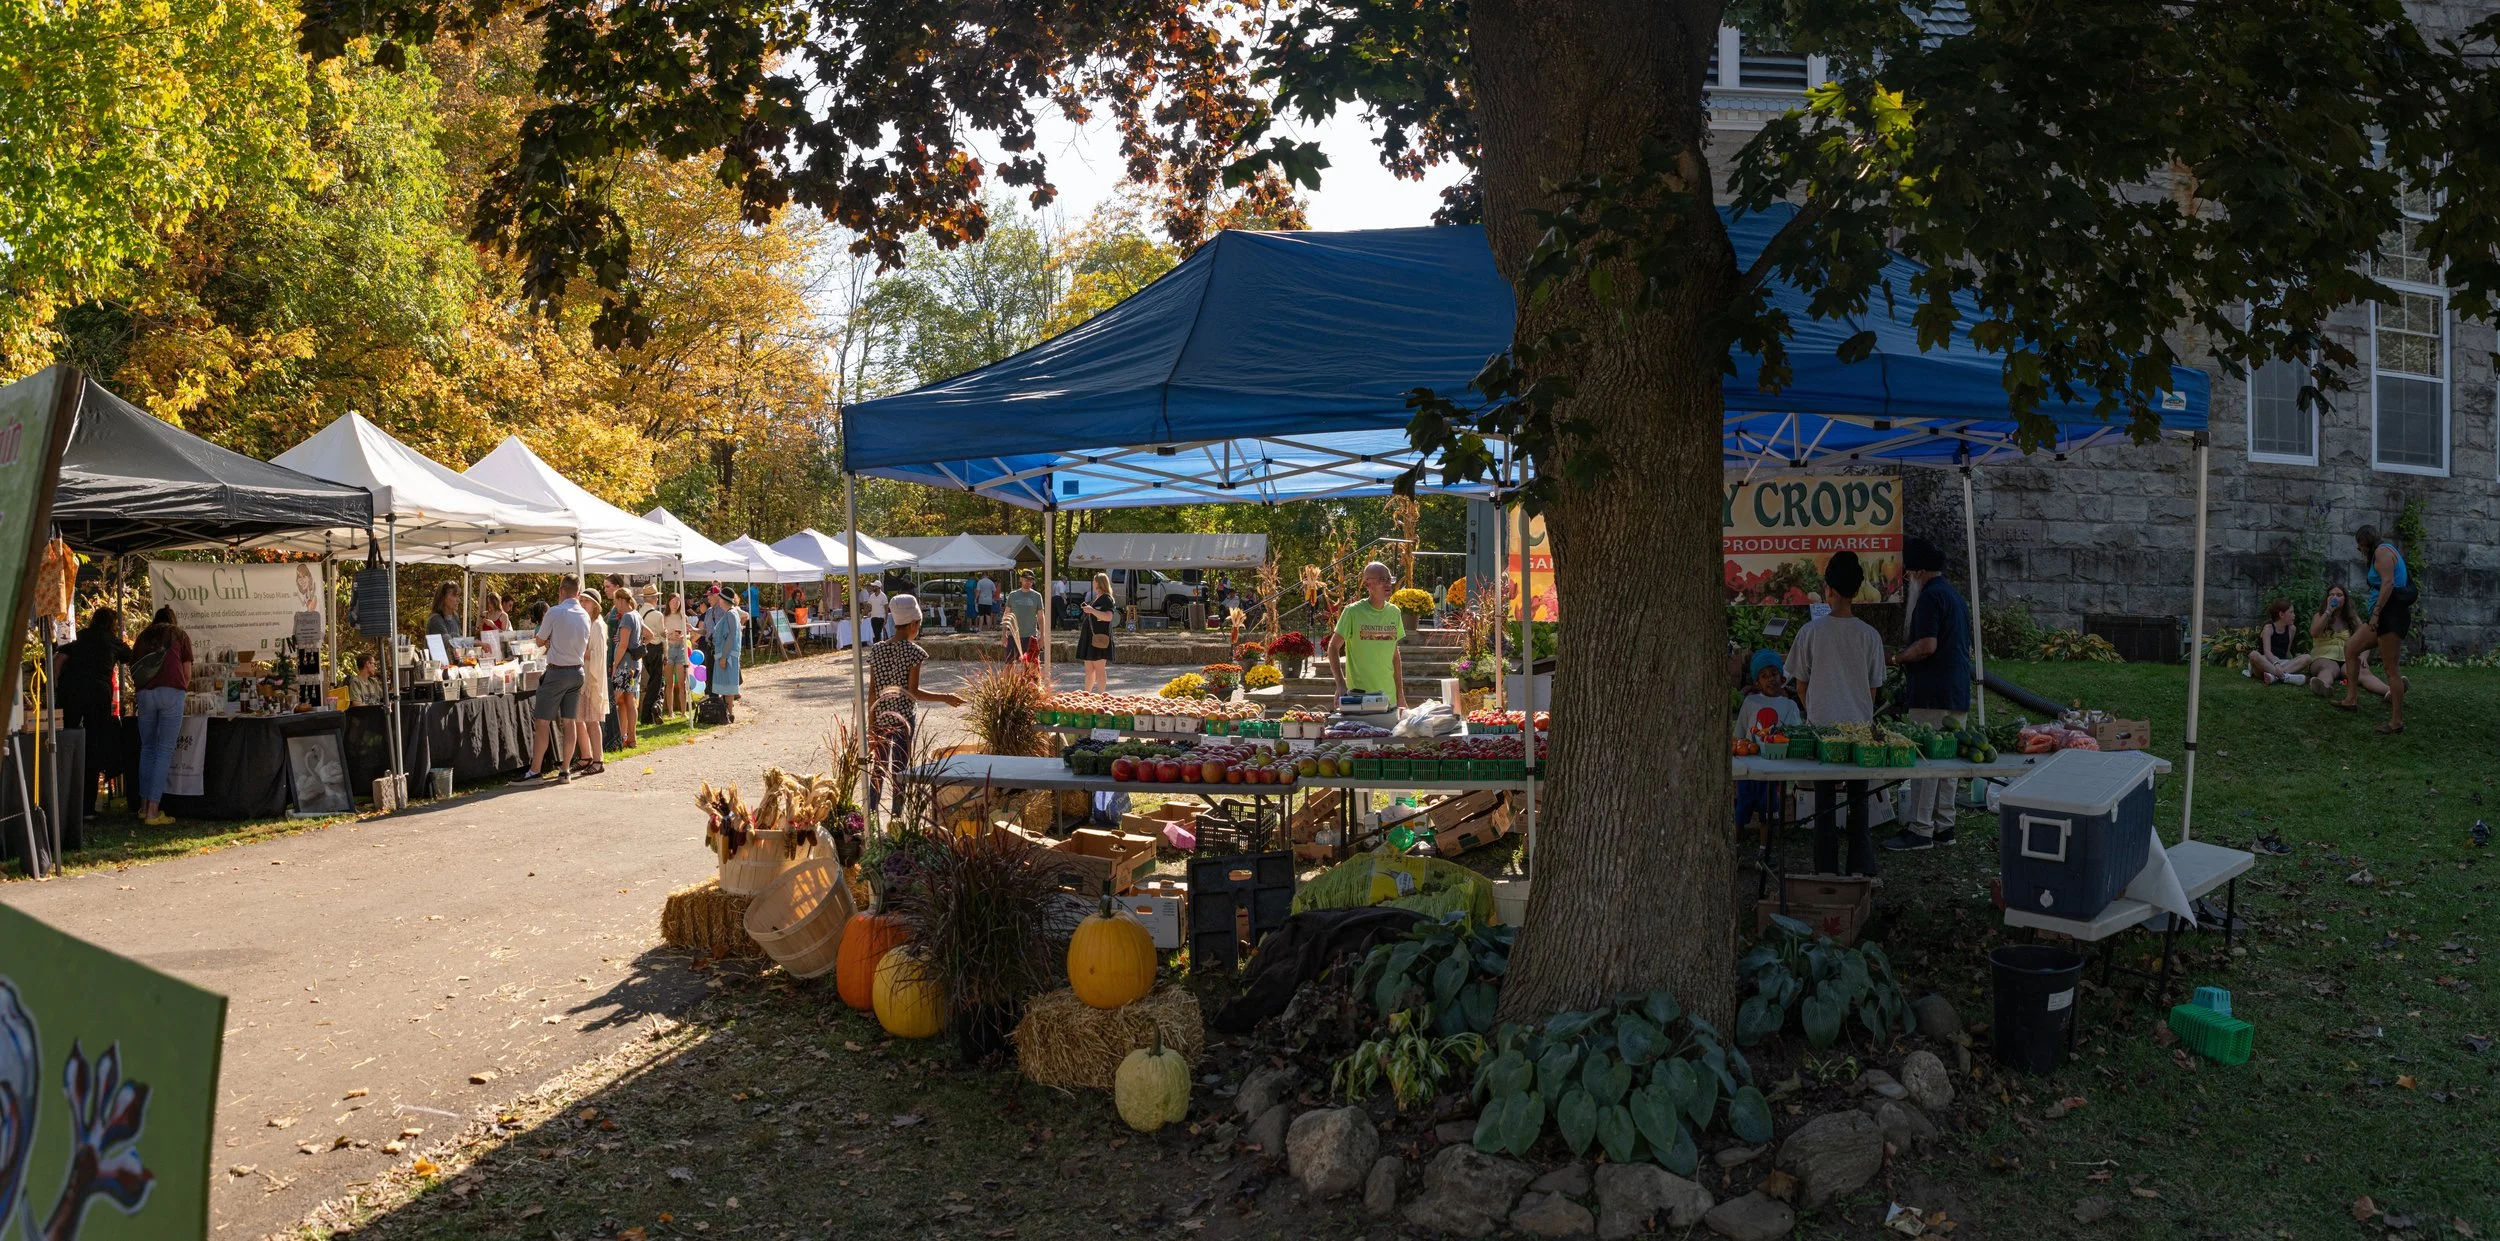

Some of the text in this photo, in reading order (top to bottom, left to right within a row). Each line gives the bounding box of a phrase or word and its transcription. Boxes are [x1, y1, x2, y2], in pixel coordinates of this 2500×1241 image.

[1754, 481, 1895, 528] CROPS
[1722, 537, 1892, 552] PRODUCE MARKET
[162, 567, 250, 606] Soup Girl
[253, 592, 262, 600] Dry
[263, 592, 275, 600] Soup
[191, 610, 210, 620] simple
[222, 609, 247, 617] delicious!
